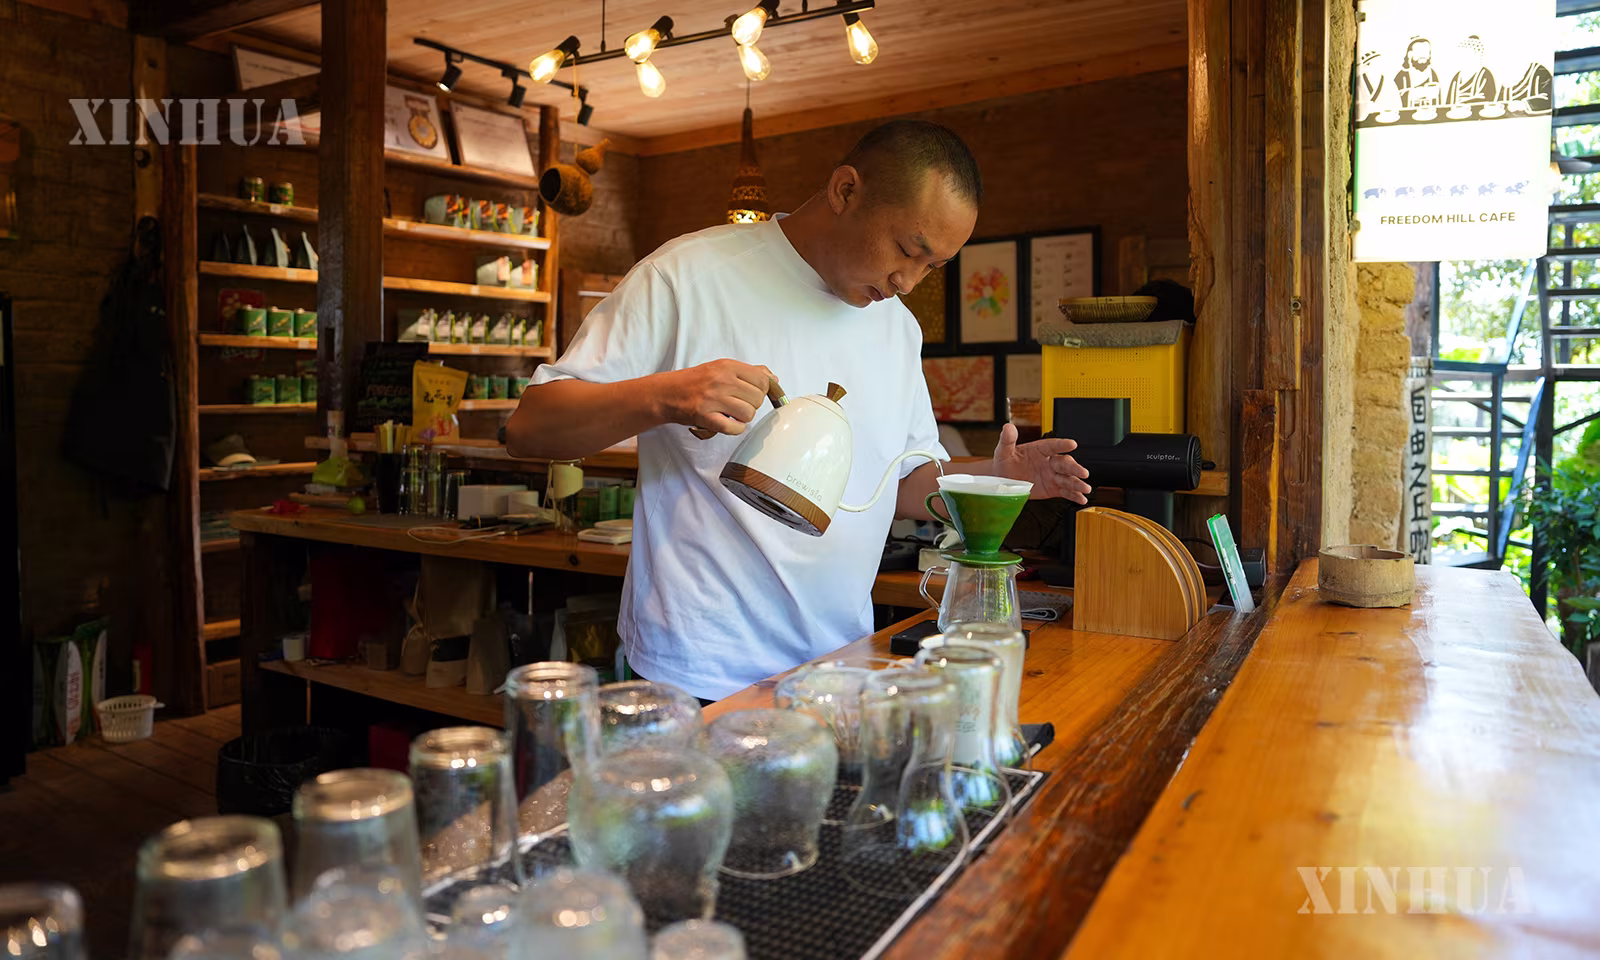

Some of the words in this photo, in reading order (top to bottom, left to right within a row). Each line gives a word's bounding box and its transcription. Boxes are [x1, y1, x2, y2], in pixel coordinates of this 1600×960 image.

[1380, 214, 1443, 225] FREEDOM
[1446, 213, 1476, 223] HILL
[1479, 211, 1516, 222] CAFE
[1146, 453, 1175, 461] sculptor
[785, 471, 823, 502] brewista
